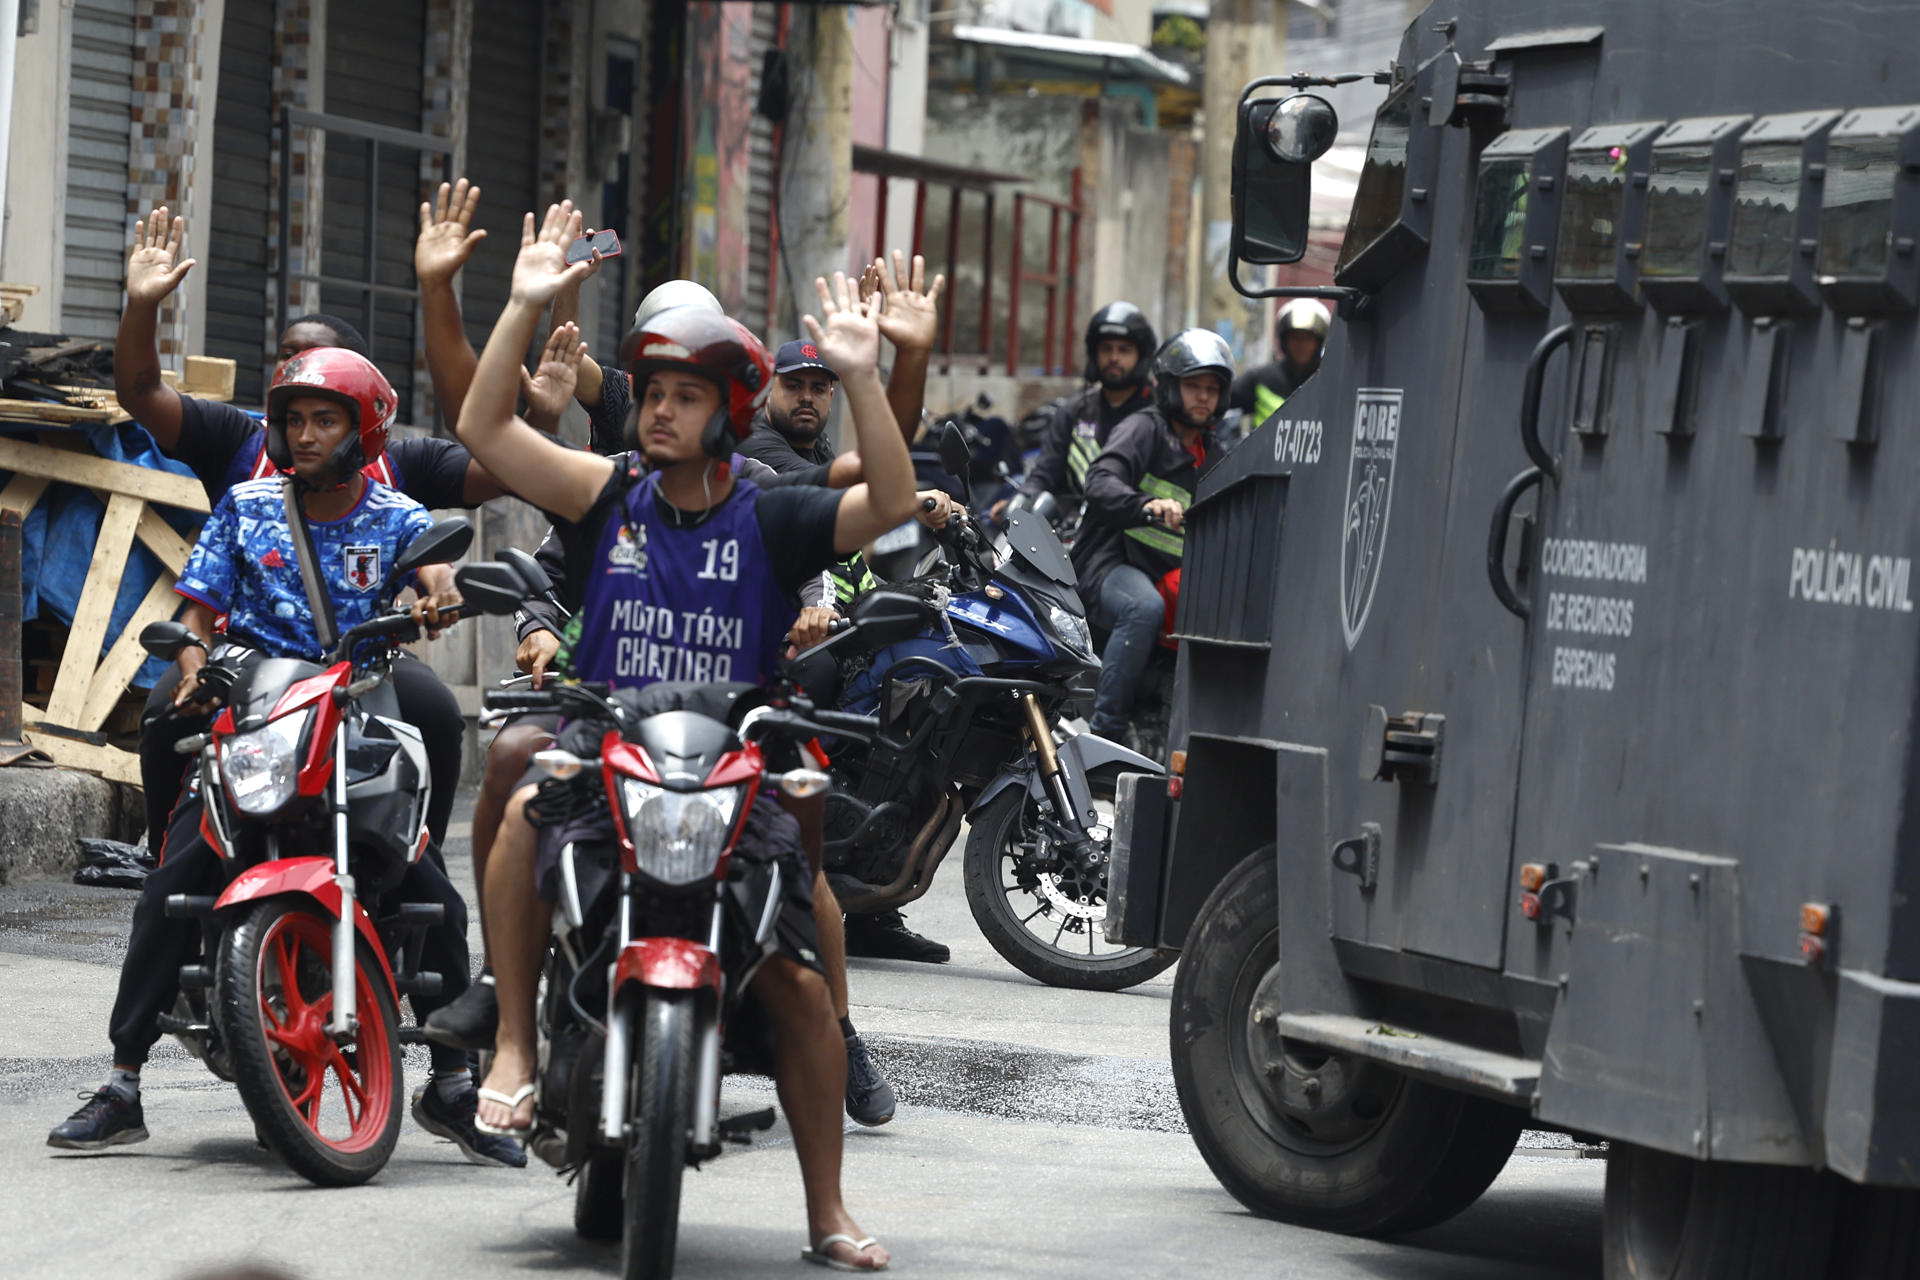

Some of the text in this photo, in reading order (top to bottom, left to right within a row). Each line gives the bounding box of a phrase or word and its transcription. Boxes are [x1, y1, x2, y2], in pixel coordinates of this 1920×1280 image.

[1274, 419, 1323, 464] 67-0723
[1357, 403, 1398, 441] CORE
[697, 538, 739, 582] 19
[1541, 537, 1647, 584] COORDENADORIA
[1789, 537, 1914, 612] POLÍCIA CIVIL
[610, 599, 743, 649] MOTO TÁXI
[1547, 591, 1635, 638] DE RECURSOS
[1552, 646, 1617, 691] ESPECIAIS
